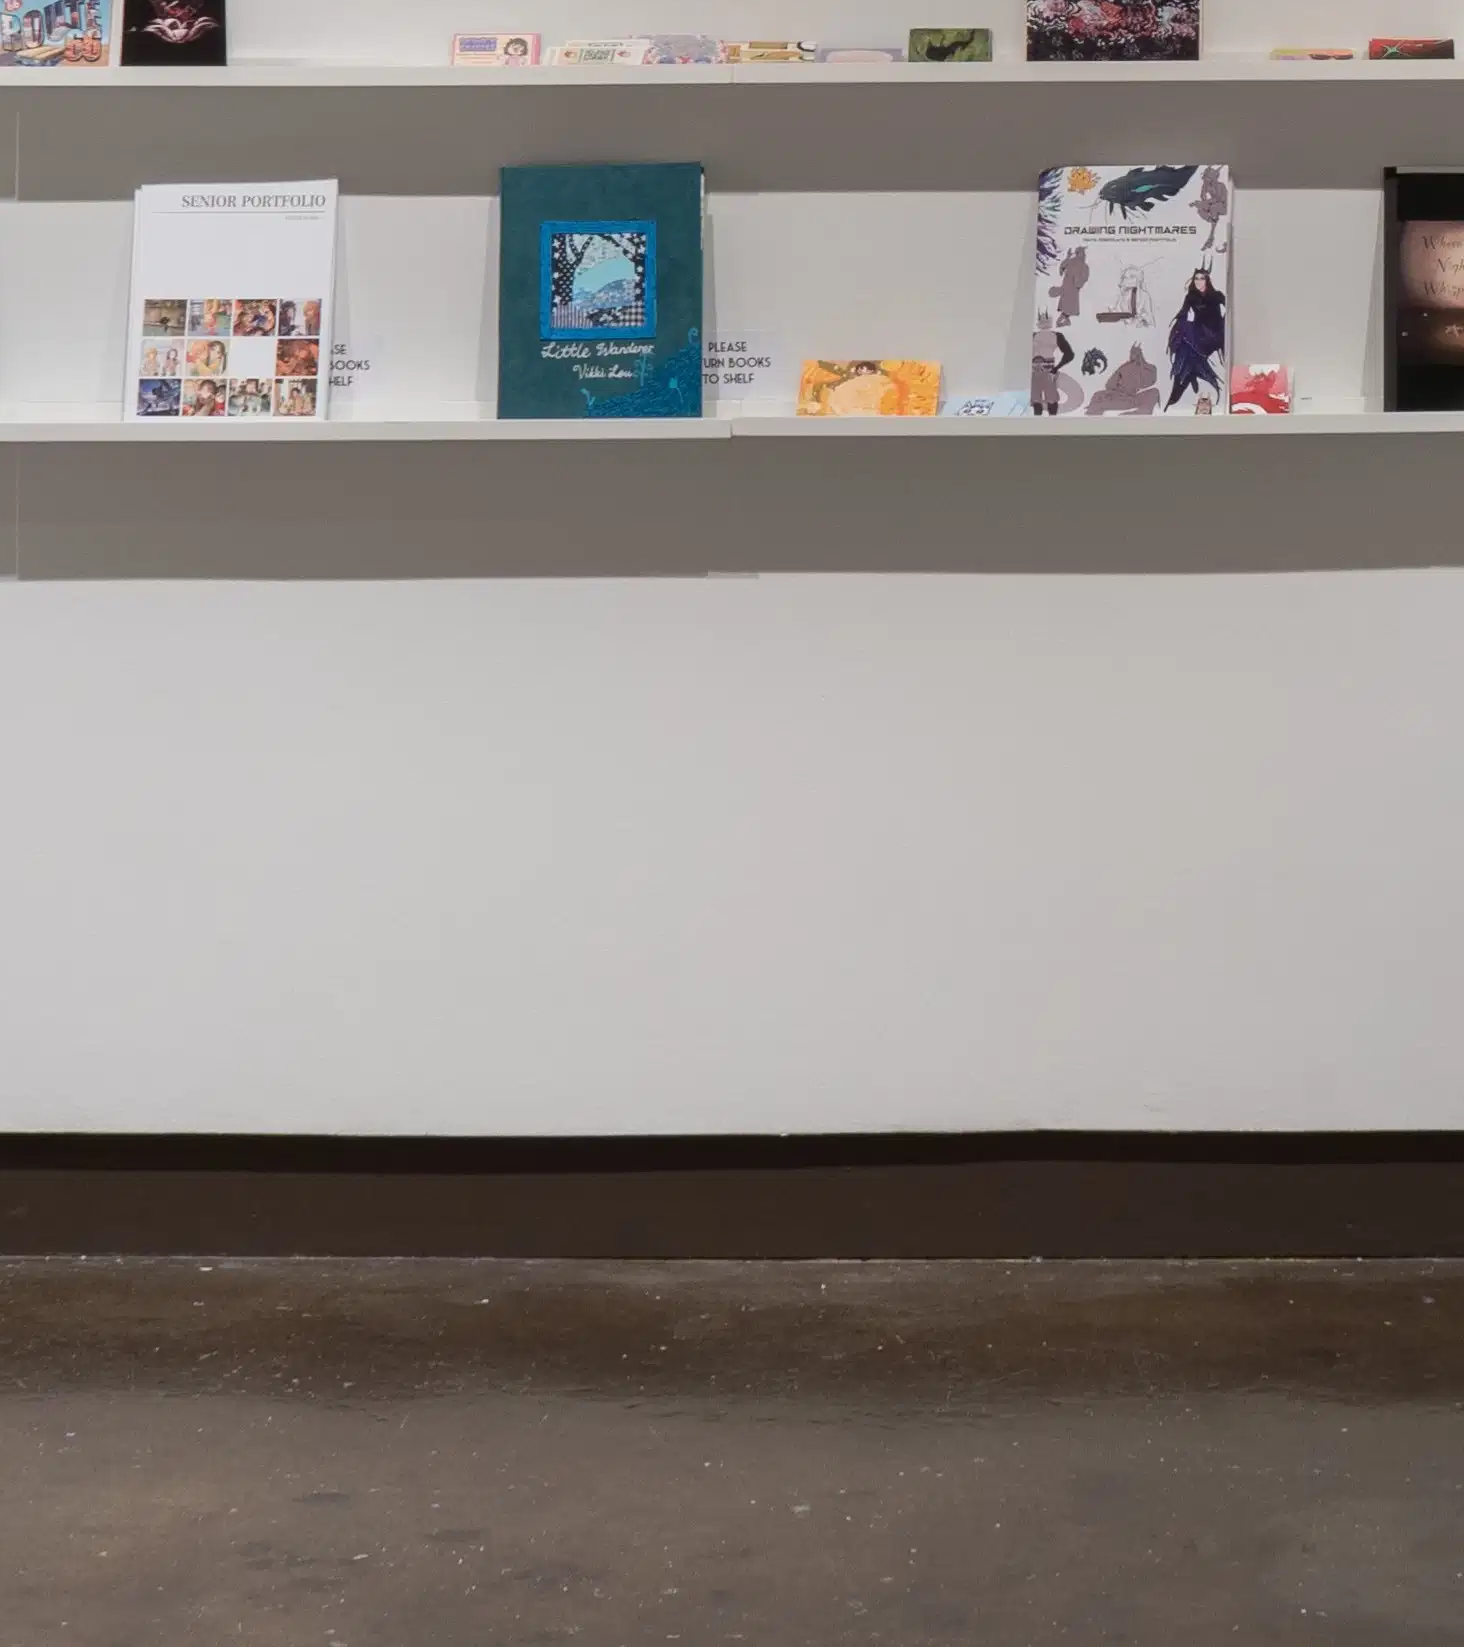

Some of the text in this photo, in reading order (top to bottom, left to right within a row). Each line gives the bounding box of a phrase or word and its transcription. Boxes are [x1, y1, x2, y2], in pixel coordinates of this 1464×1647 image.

[64, 28, 102, 62] 66
[181, 193, 326, 208] SENIOR PORTFOLIO
[1064, 226, 1197, 235] DRAWING NIGHTMARES
[540, 341, 655, 360] Little Wanderer
[708, 341, 748, 353] PLEASE
[703, 357, 772, 368] URN BOOKS
[572, 363, 606, 380] Vikki
[329, 375, 354, 387] HELF
[702, 373, 755, 385] TO SHELF
